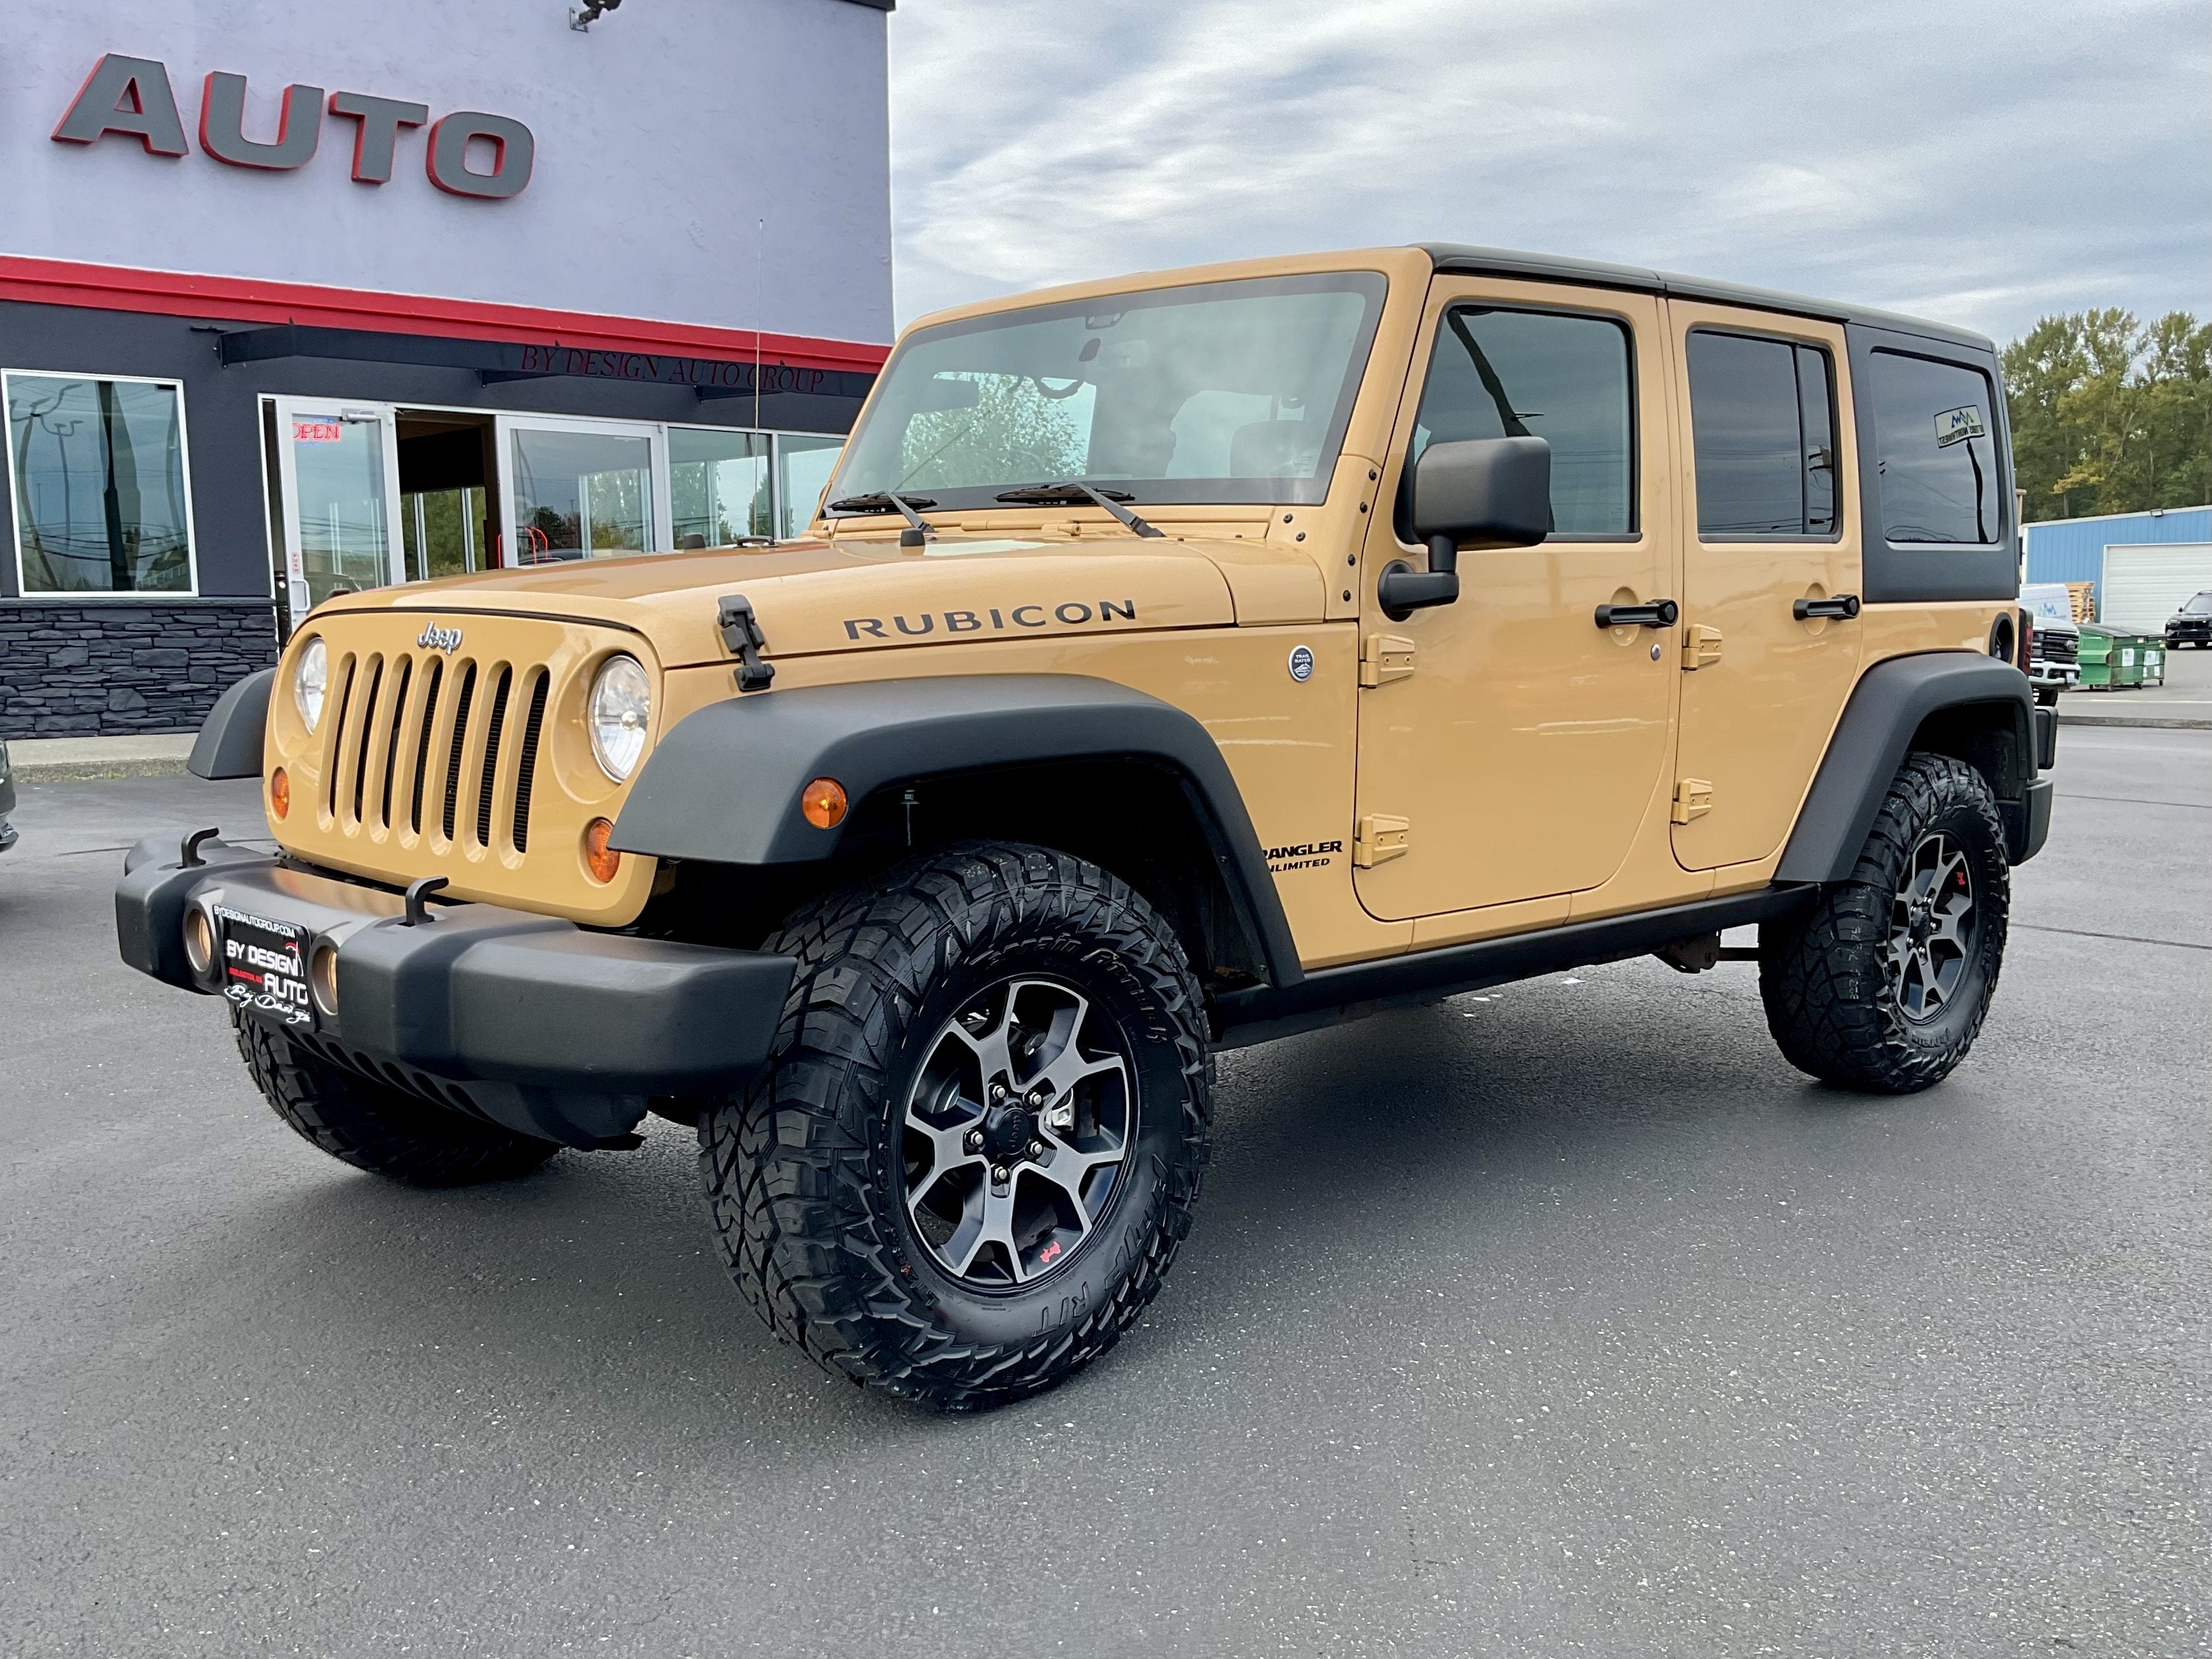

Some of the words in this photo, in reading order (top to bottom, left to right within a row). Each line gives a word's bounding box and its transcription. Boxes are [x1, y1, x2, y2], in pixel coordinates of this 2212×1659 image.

[51, 53, 536, 199] AUTO
[521, 346, 561, 372] BY
[566, 349, 661, 379] DESIGN
[668, 359, 740, 386] AUTO
[748, 364, 824, 393] GROUP
[418, 621, 463, 655] Jeep
[843, 599, 1136, 640] RUBICON
[214, 905, 296, 938] BYDESIGNAUTOGROUP.COM
[226, 939, 245, 960] BY
[248, 945, 299, 977] DESIGN
[264, 973, 309, 1005] AUTO
